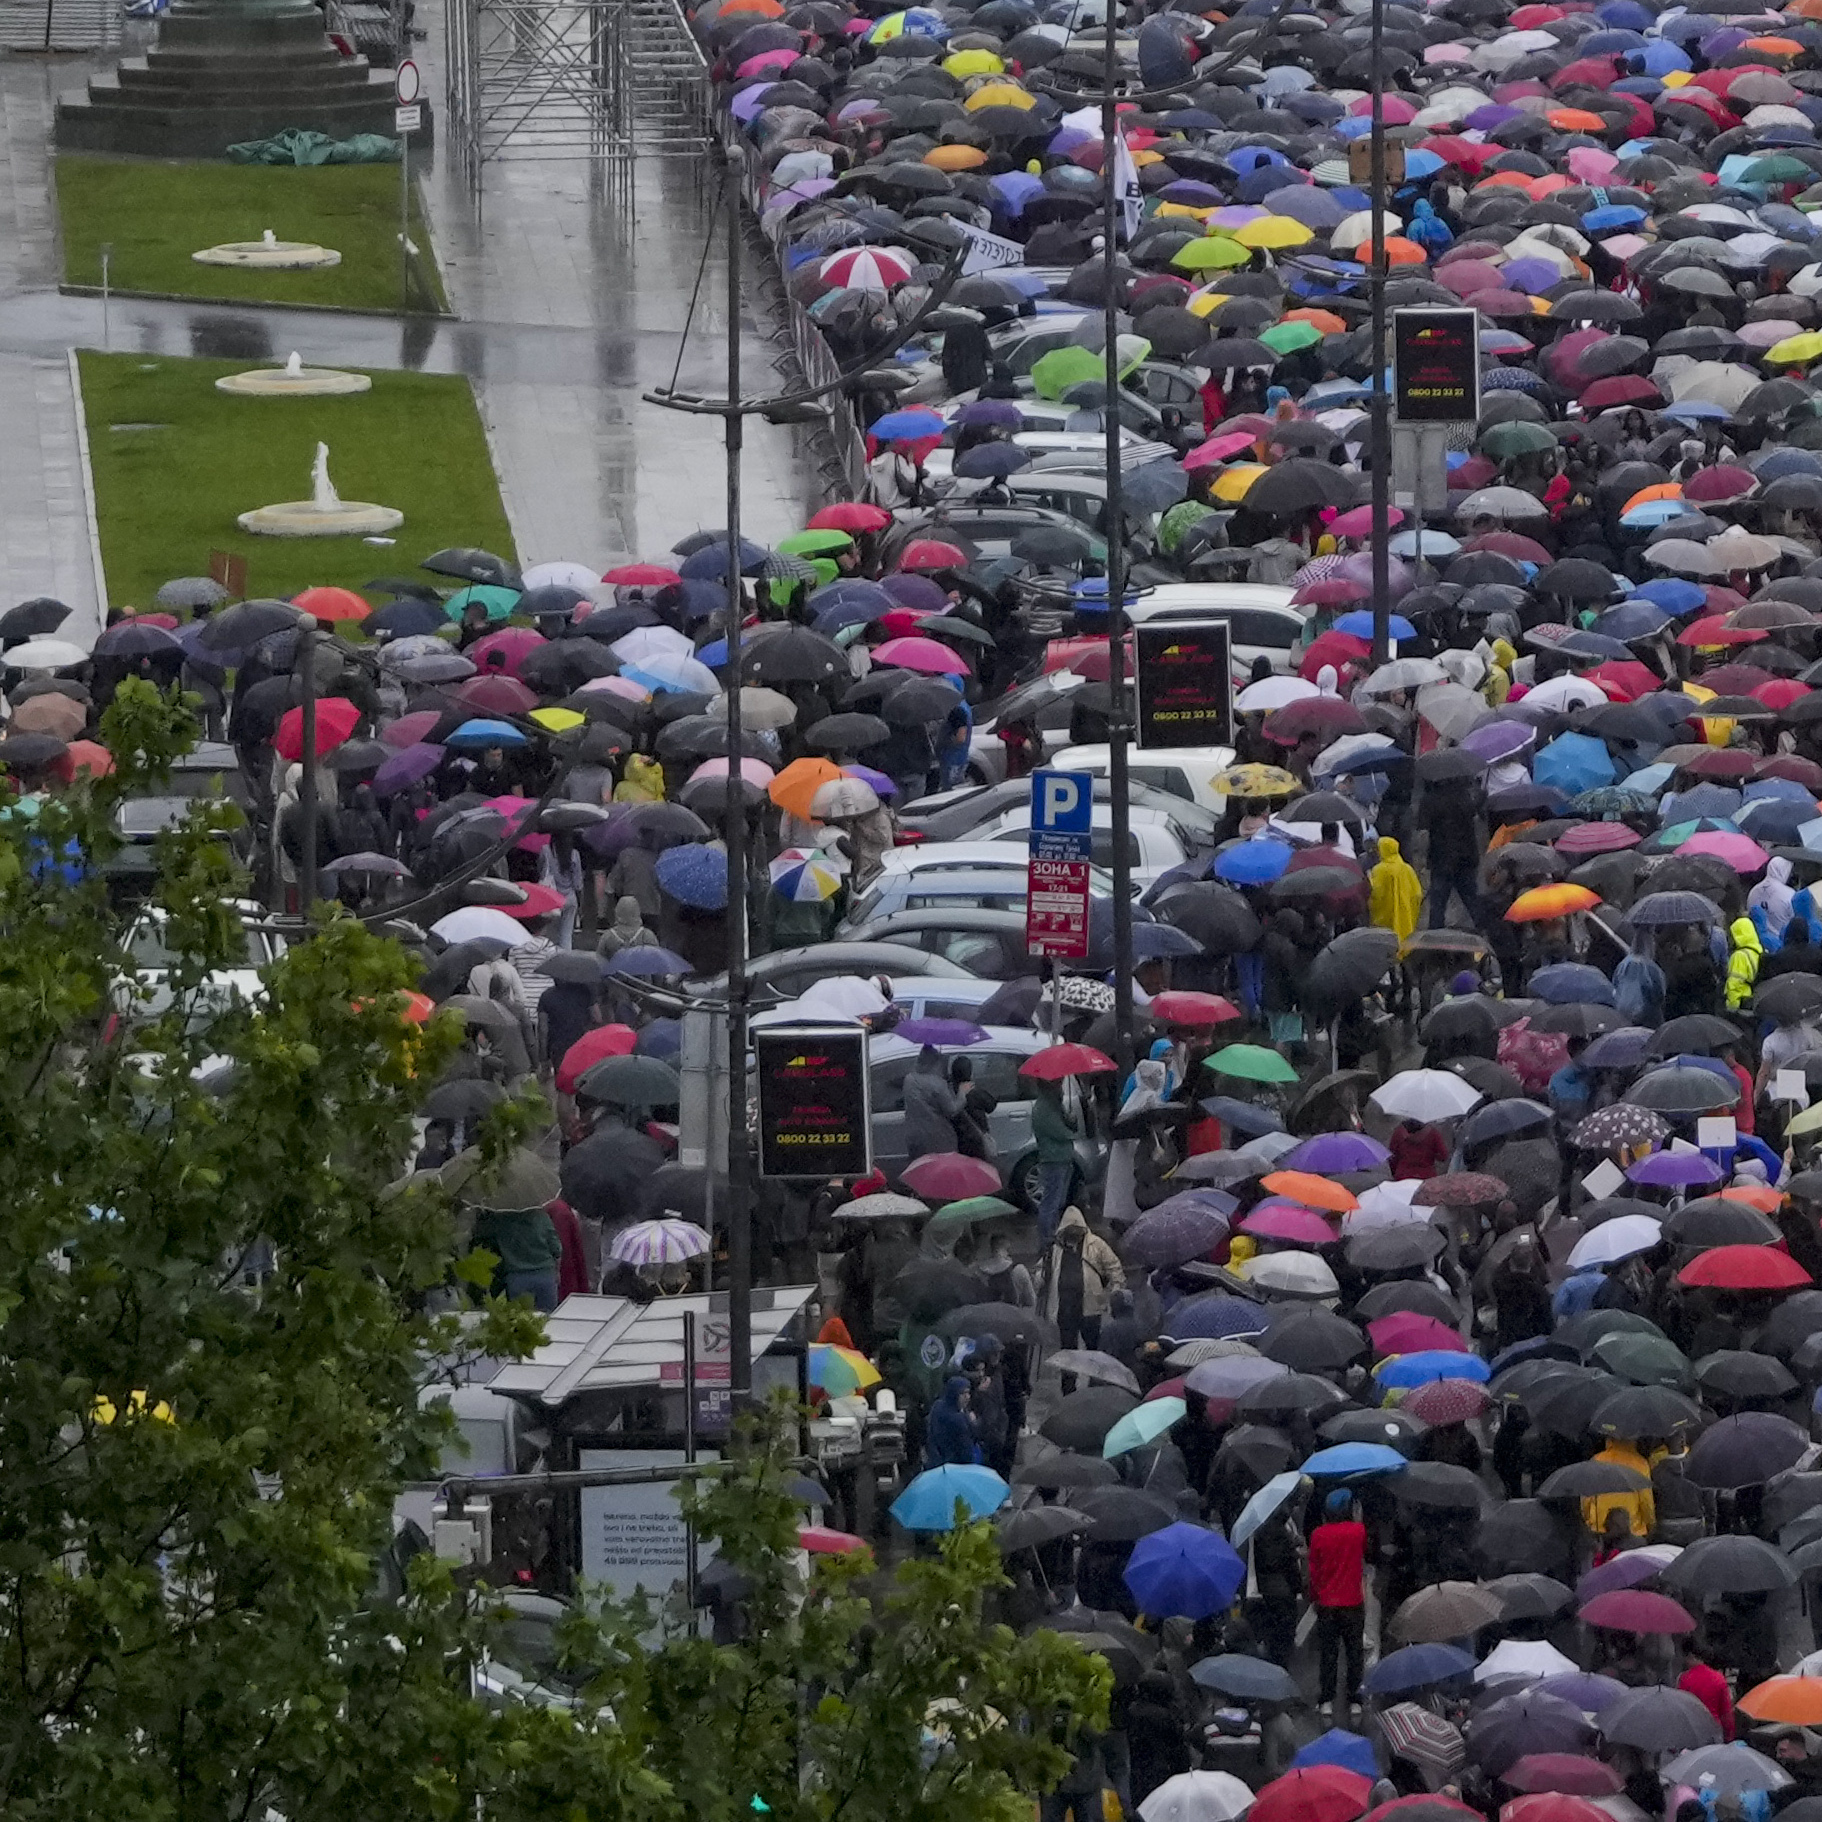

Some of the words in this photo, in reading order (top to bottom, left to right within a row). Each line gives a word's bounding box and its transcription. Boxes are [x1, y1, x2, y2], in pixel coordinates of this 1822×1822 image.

[1407, 388, 1431, 397] 0800
[1153, 711, 1178, 721] 0800
[1044, 777, 1079, 826] P
[1033, 862, 1071, 876] ЗОНА
[1079, 865, 1086, 876] 1
[776, 1134, 806, 1144] 0800
[808, 1134, 822, 1144] 22
[822, 1134, 835, 1144] 33
[835, 1133, 850, 1143] 22
